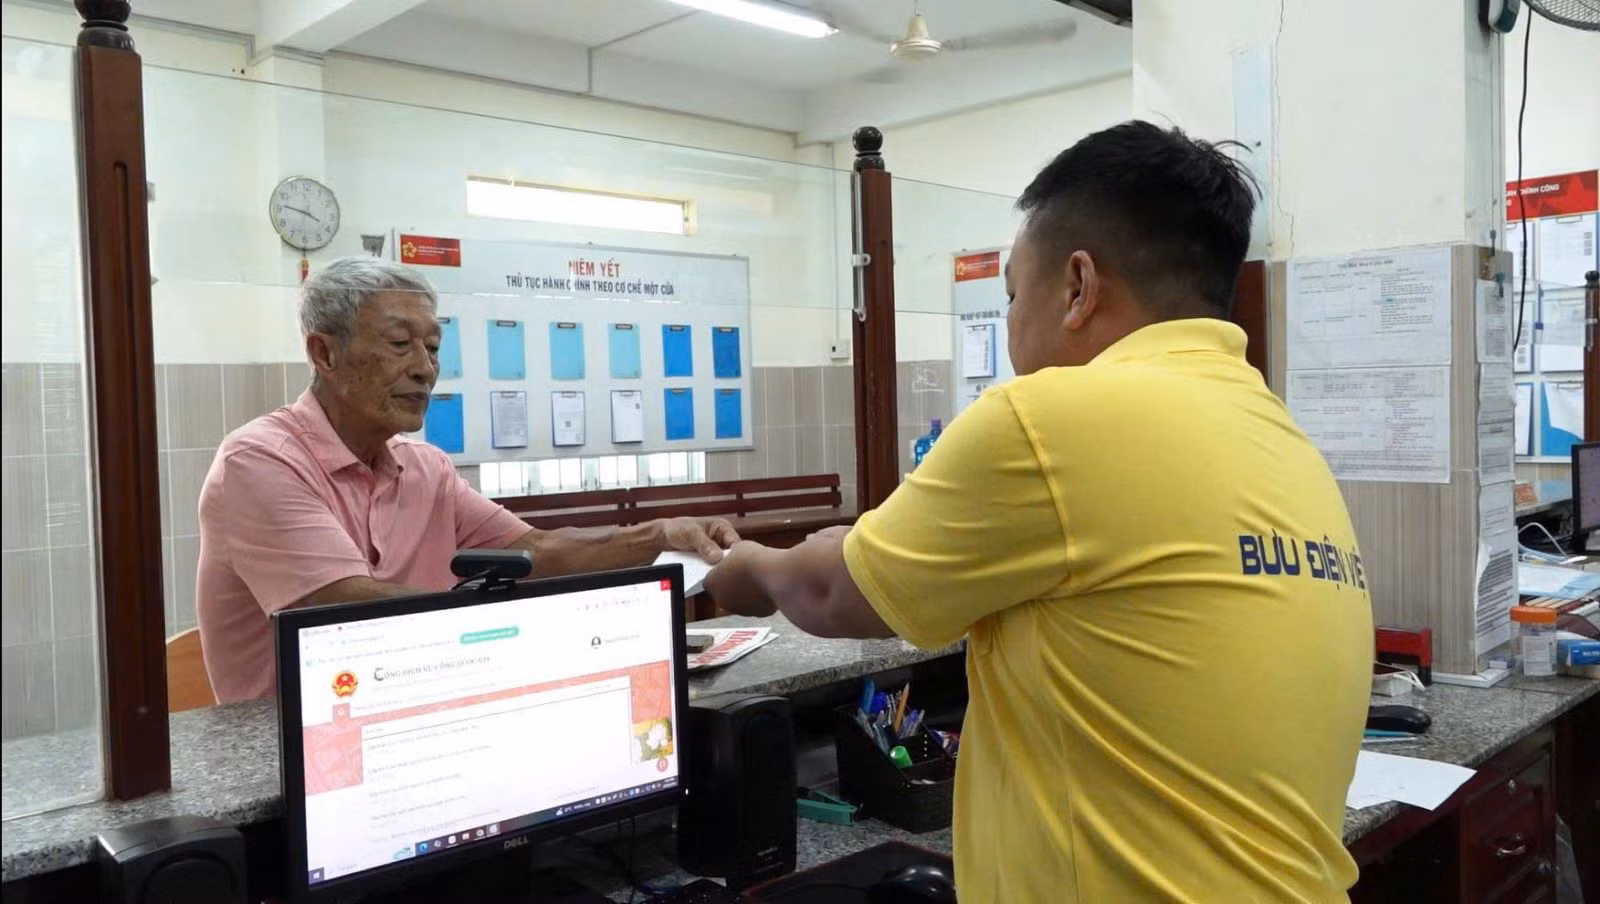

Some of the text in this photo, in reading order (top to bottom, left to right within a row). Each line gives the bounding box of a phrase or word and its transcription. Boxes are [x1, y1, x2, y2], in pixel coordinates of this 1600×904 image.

[1540, 183, 1560, 193] CÔNG
[600, 257, 621, 278] YẾT
[506, 272, 523, 288] THỦ
[525, 276, 541, 291] TỤC
[543, 275, 565, 291] HÀNH
[593, 280, 614, 293] THEO
[627, 278, 642, 294] CHẾ
[644, 281, 659, 297] MỘT
[1238, 528, 1301, 576] BƯU
[1304, 534, 1348, 591] ĐIỆN
[503, 835, 529, 849] DELL
